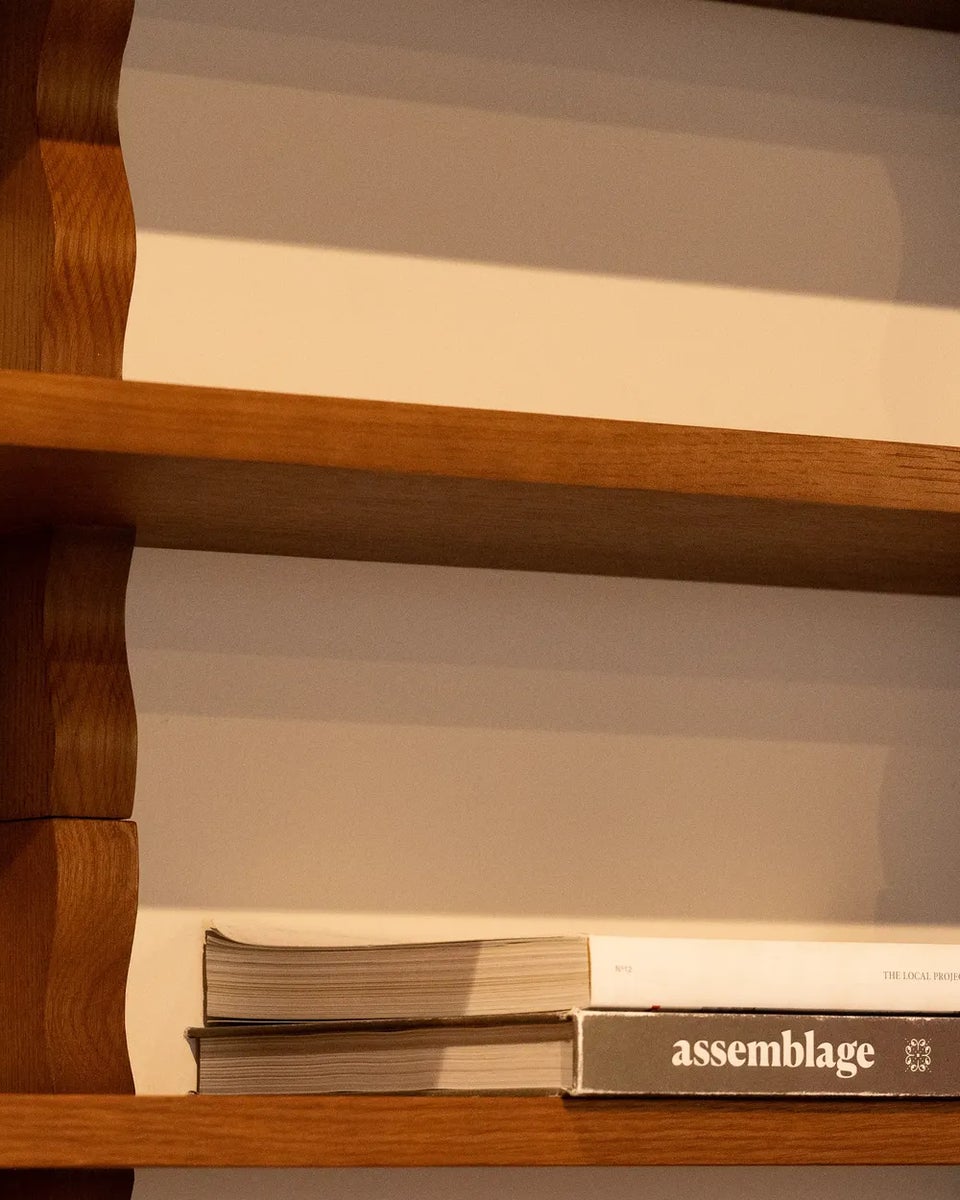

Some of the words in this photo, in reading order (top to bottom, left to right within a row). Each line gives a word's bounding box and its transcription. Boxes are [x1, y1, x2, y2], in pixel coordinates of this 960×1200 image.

[883, 971, 901, 980] THE
[902, 971, 931, 980] LOCAL
[672, 1030, 875, 1079] assemblage
